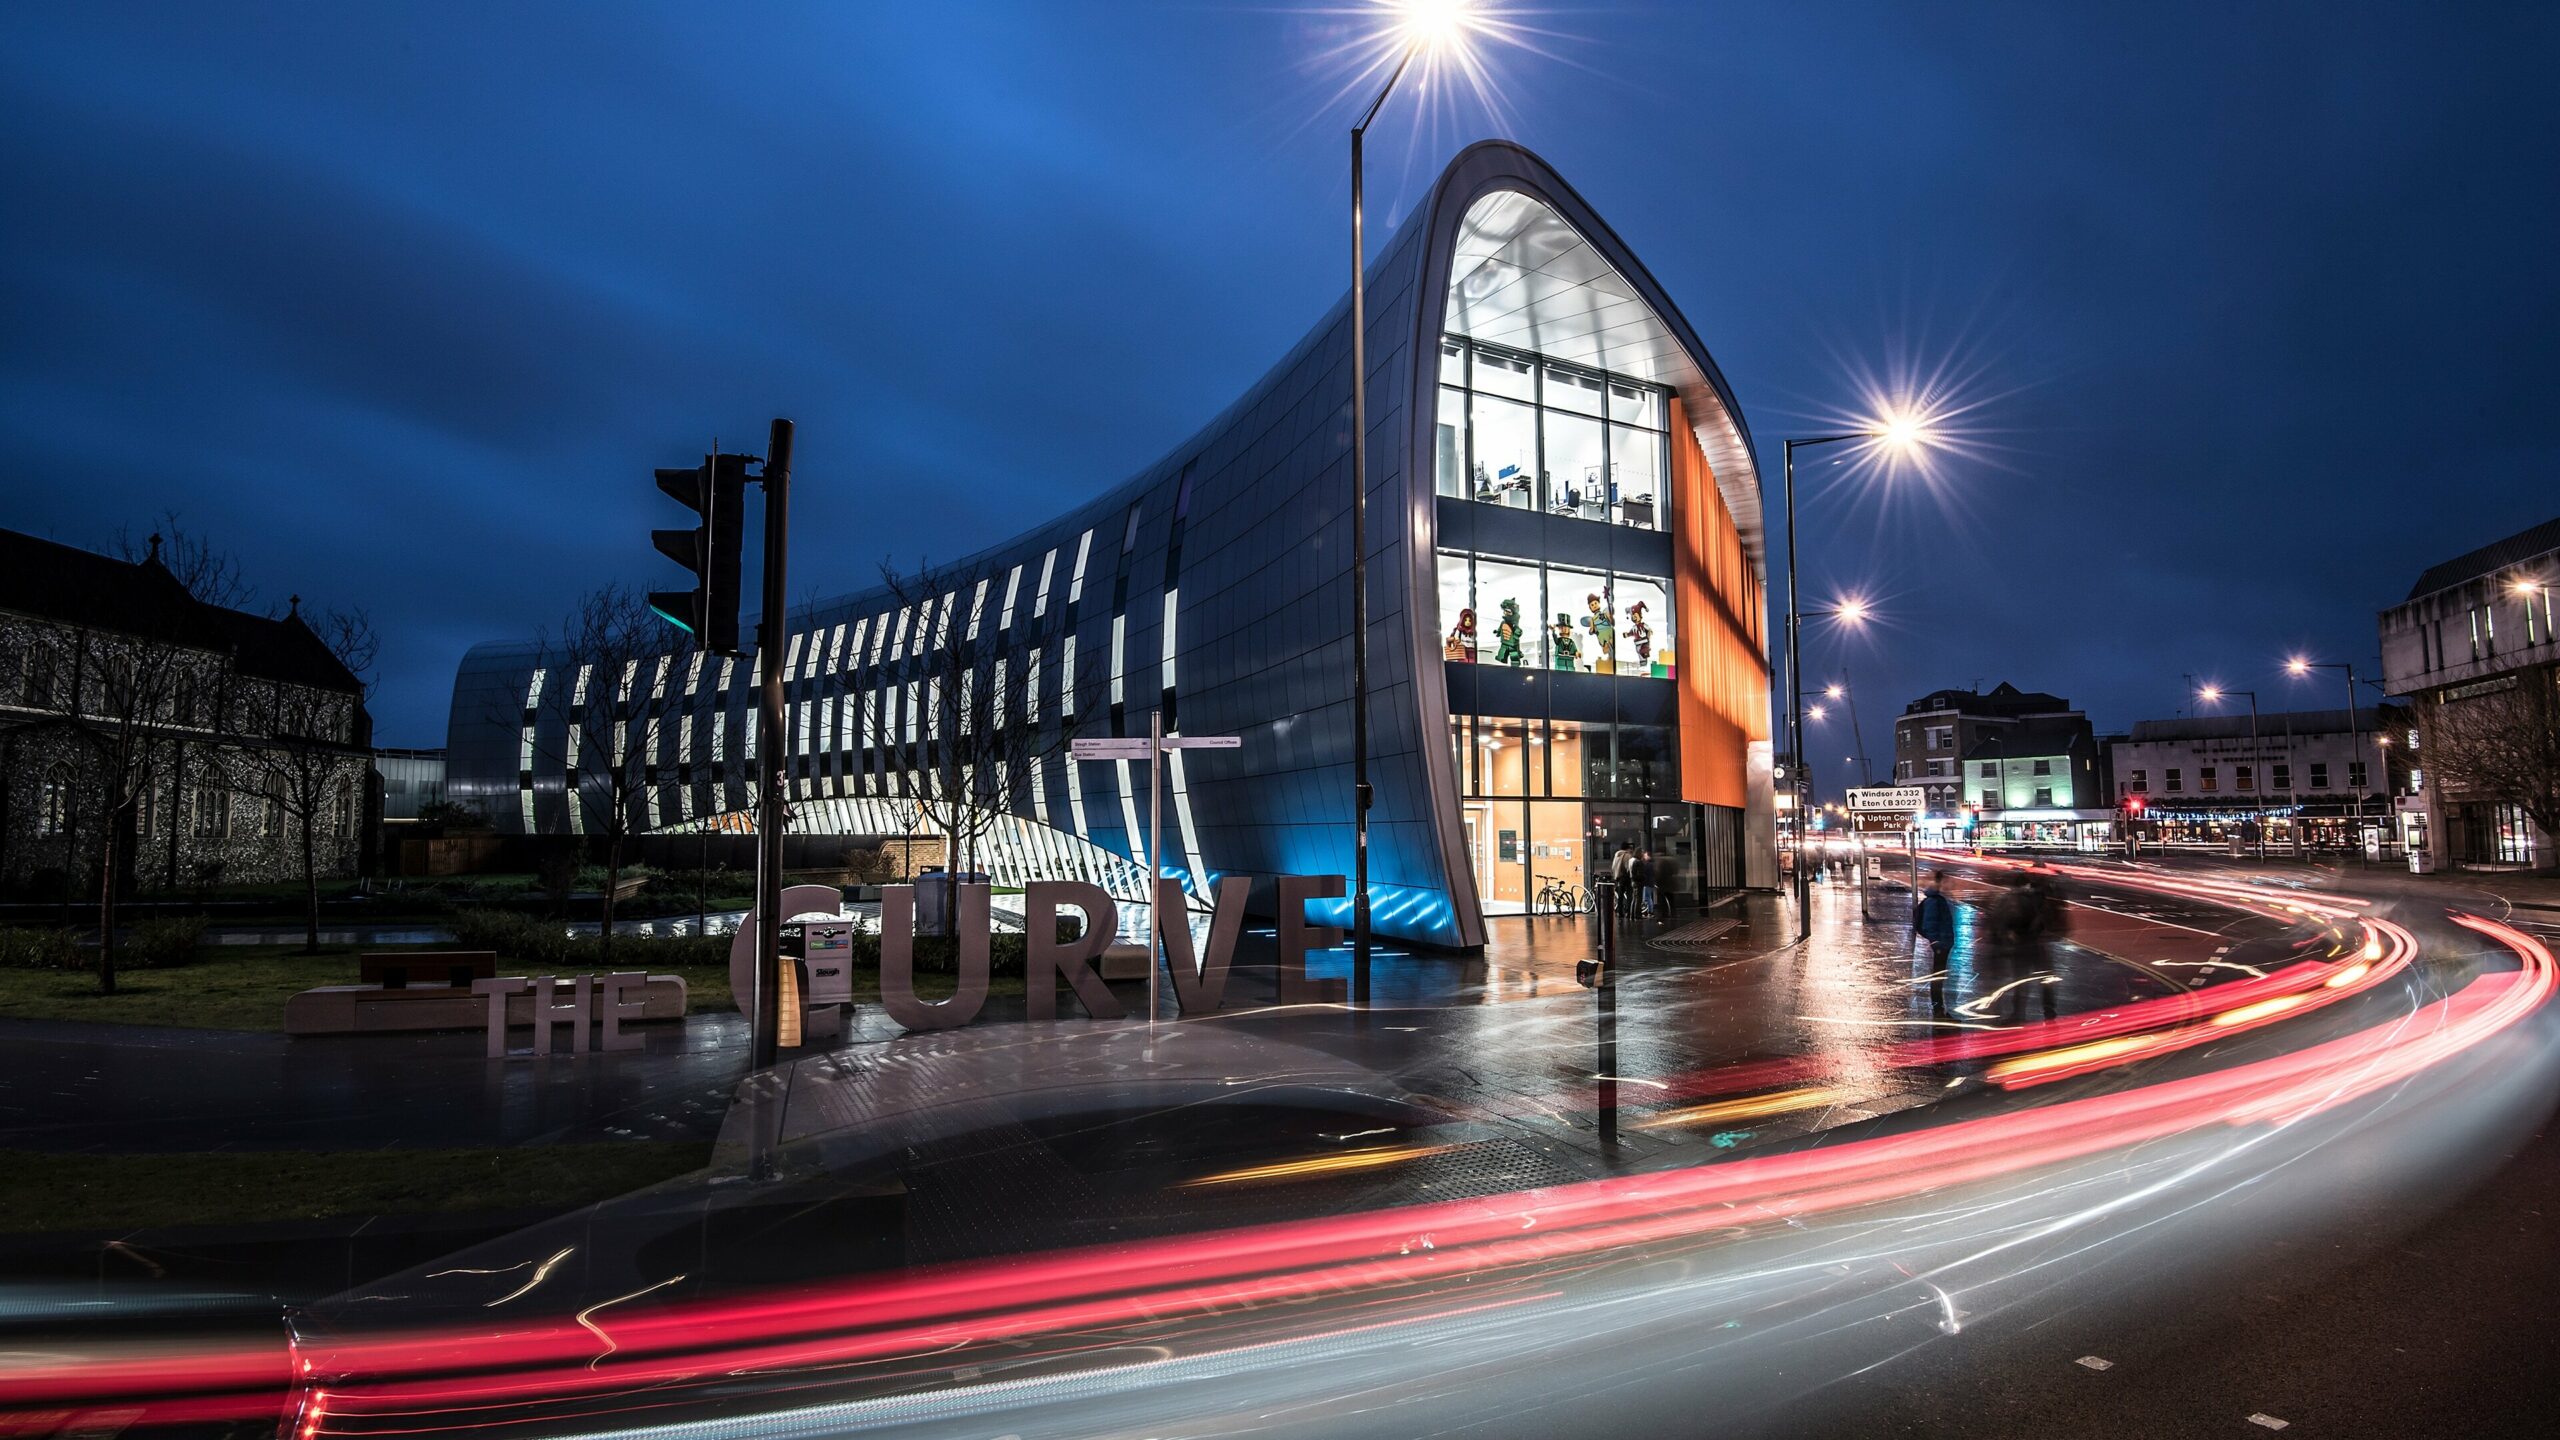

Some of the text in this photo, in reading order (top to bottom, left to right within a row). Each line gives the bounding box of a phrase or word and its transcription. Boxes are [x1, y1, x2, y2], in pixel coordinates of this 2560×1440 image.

[1882, 799, 1922, 807] (B3022)
[1867, 814, 1891, 822] Upton
[729, 875, 1348, 1038] CURVE
[816, 968, 840, 977] Slough
[471, 971, 648, 1058] THE
